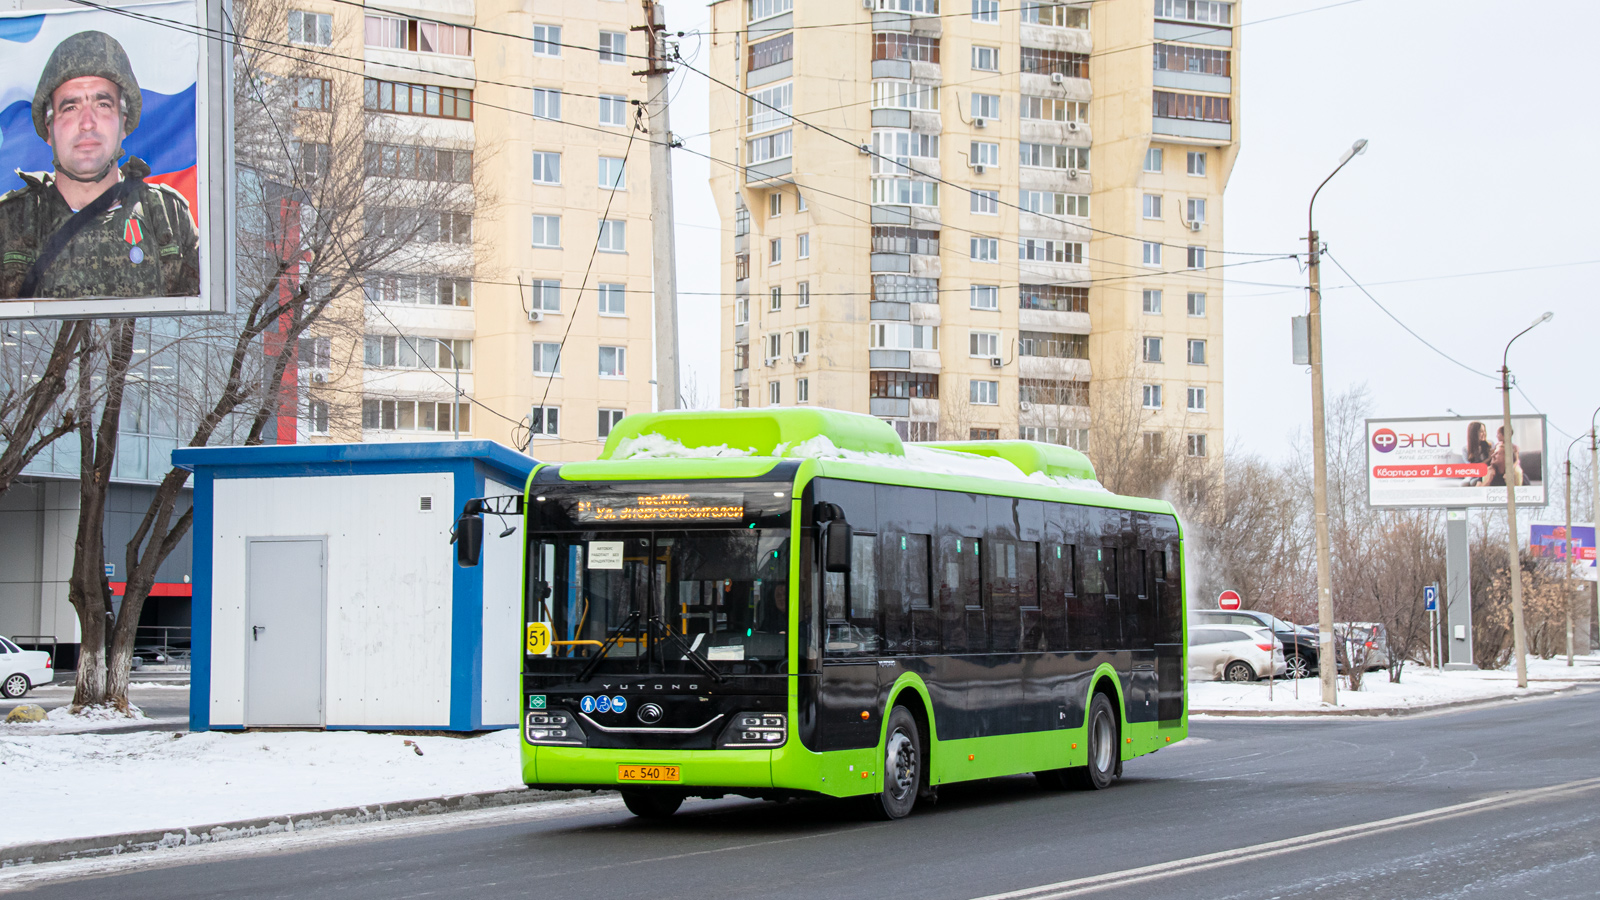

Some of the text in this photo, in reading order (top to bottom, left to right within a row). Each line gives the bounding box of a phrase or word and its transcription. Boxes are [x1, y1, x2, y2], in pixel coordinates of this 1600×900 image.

[1374, 432, 1450, 448] ФЭНСИ
[1377, 468, 1417, 477] Квартира
[1445, 467, 1452, 475] в
[1455, 467, 1479, 475] месяц
[529, 630, 546, 647] 51
[640, 767, 660, 779] 540
[665, 767, 676, 777] 72
